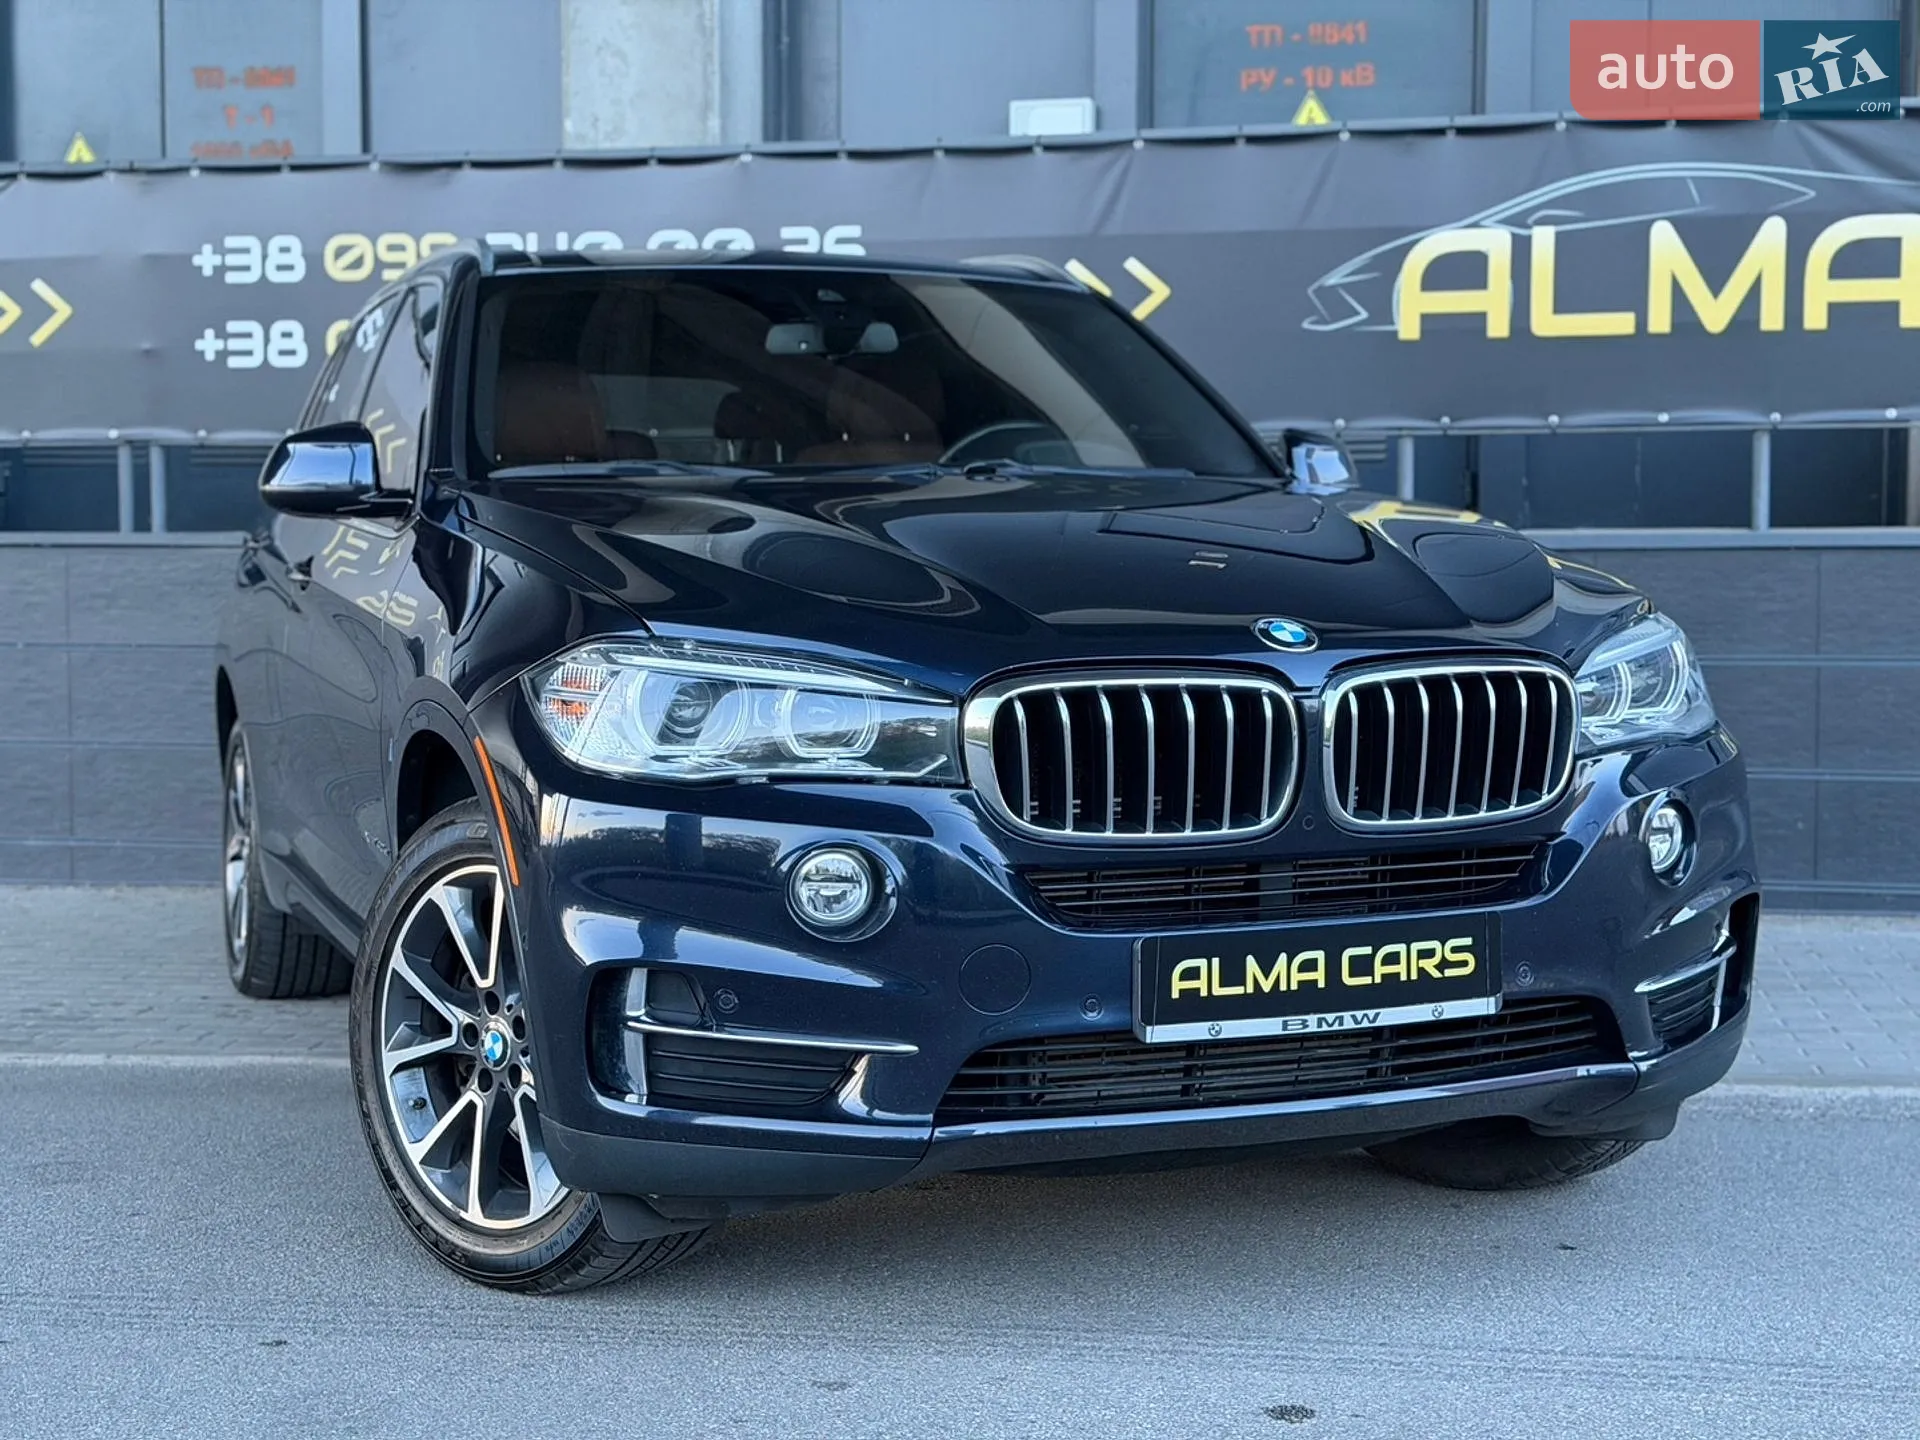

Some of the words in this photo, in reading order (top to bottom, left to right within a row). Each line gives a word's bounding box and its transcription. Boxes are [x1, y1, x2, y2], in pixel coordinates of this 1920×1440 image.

[192, 234, 306, 284] +38
[1397, 213, 1920, 341] ALMA
[194, 319, 308, 368] +38
[1171, 949, 1326, 999] ALMA
[1341, 936, 1477, 986] CARS
[1281, 1011, 1382, 1032] BMW
